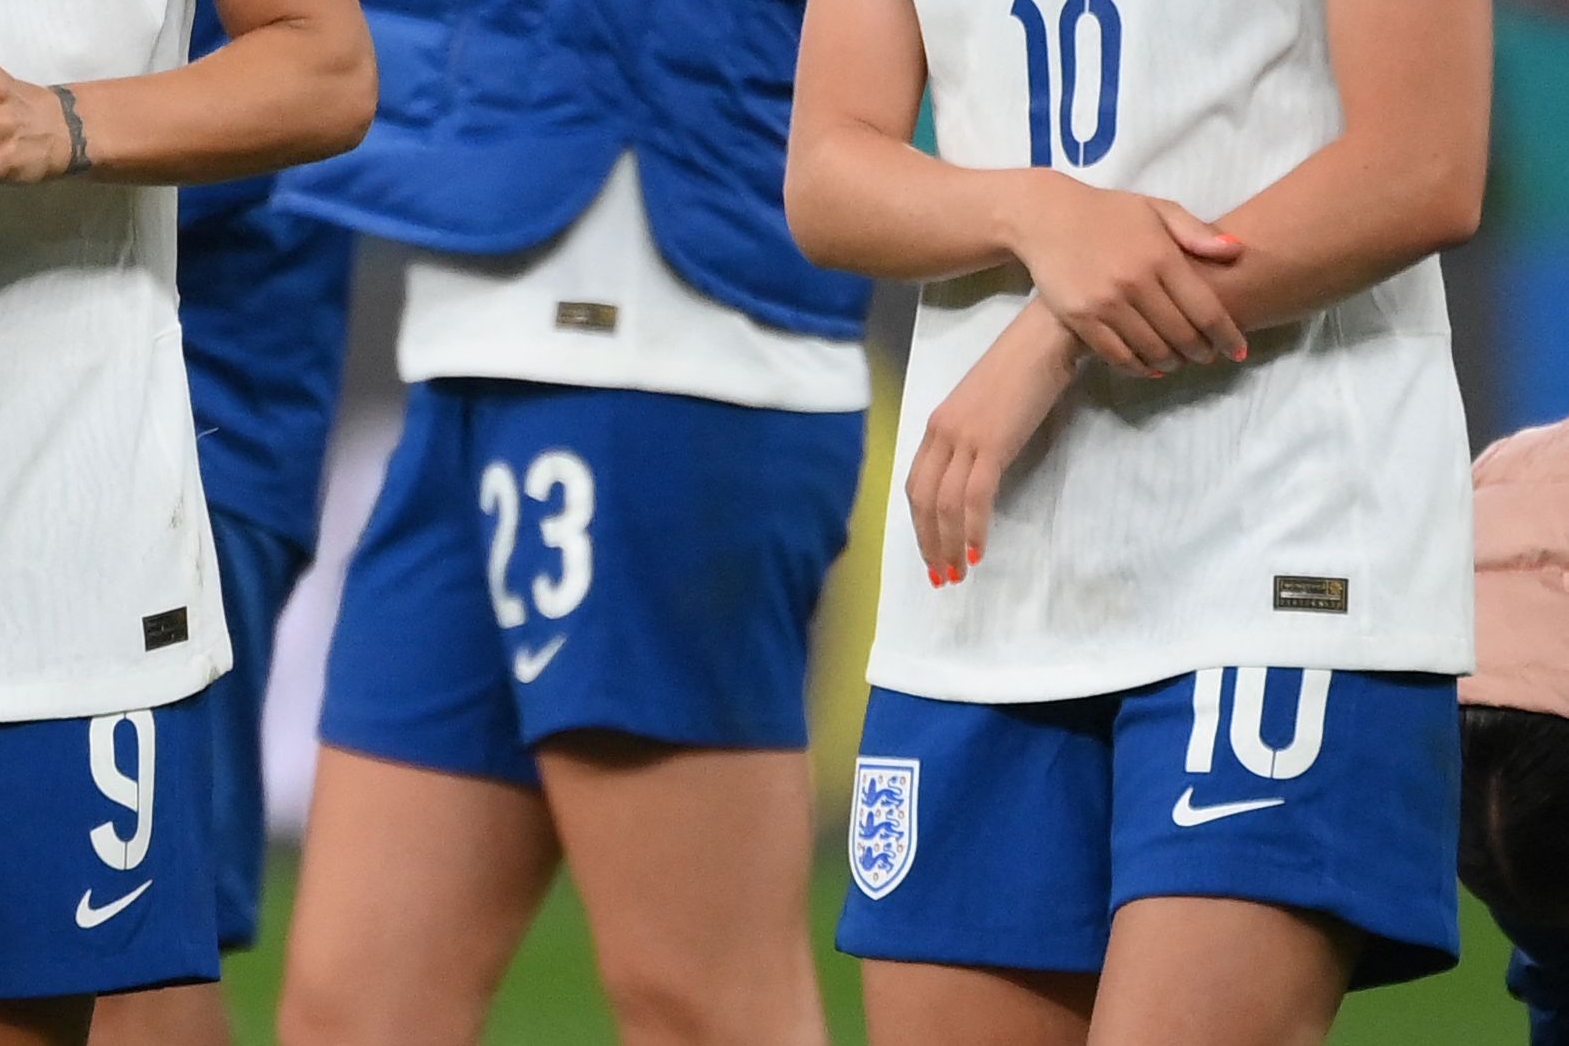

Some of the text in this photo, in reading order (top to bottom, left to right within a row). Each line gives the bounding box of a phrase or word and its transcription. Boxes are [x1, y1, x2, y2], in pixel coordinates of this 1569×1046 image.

[479, 450, 596, 630] 23
[89, 708, 156, 871] 9
[1185, 666, 1332, 780] 10
